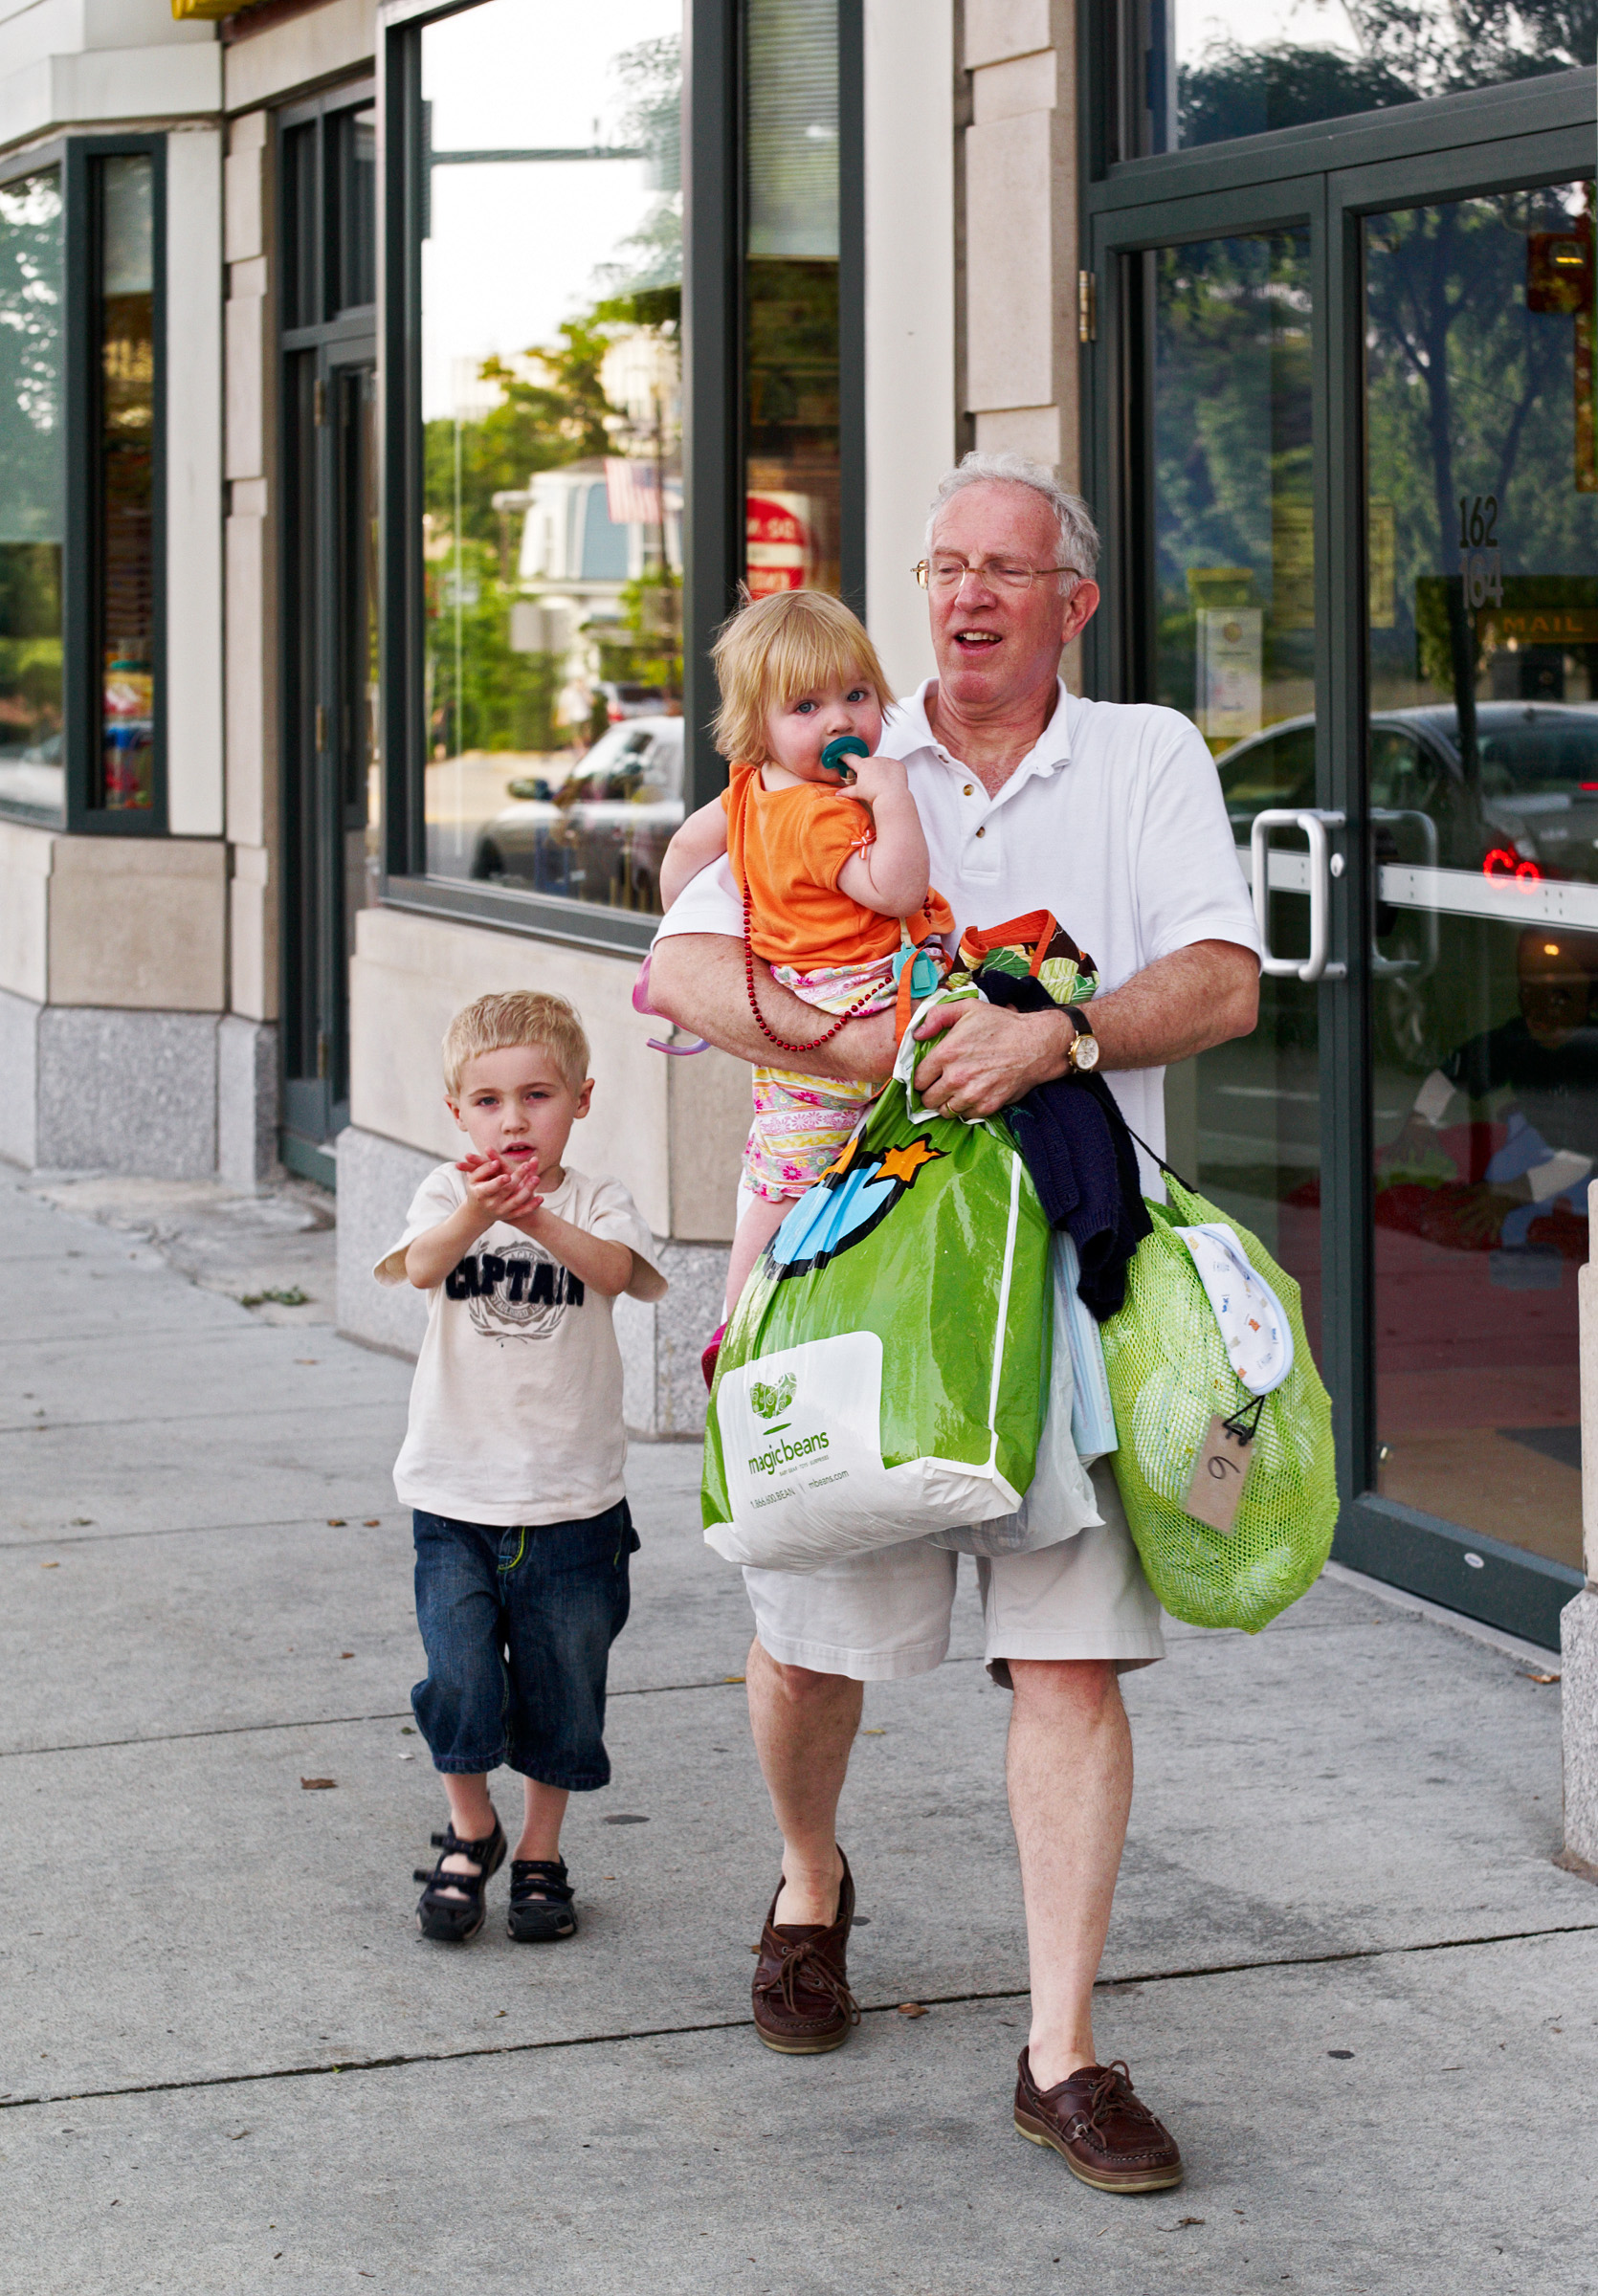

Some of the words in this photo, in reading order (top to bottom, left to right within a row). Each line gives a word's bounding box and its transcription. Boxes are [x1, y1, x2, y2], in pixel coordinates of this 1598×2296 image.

[1459, 495, 1498, 548] 162
[1459, 551, 1504, 608] 164
[1503, 616, 1584, 632] MAIL
[446, 1253, 585, 1307] CAPTAIN
[748, 1444, 784, 1475] magic
[780, 1432, 830, 1462] beans
[809, 1470, 849, 1490] mbeans.com
